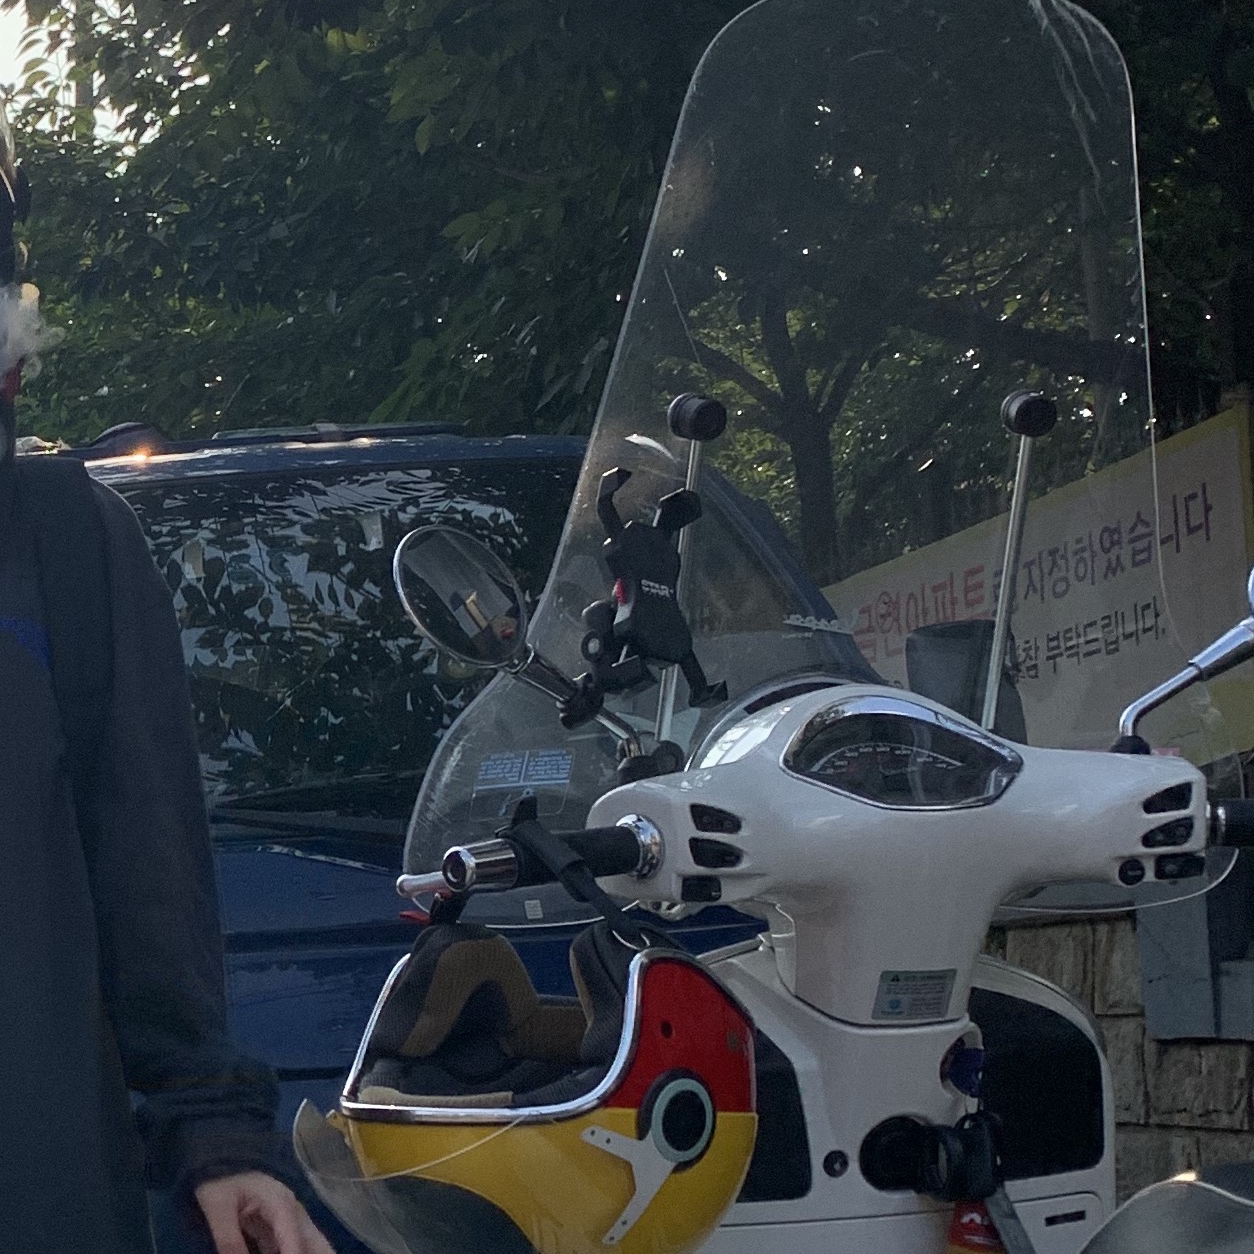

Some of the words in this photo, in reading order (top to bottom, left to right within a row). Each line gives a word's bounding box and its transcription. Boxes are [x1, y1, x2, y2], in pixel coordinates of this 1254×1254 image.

[853, 564, 1018, 664] 금연아파트
[1022, 481, 1213, 604] 지정하였습니다
[1045, 595, 1166, 674] 부탁드립니다.
